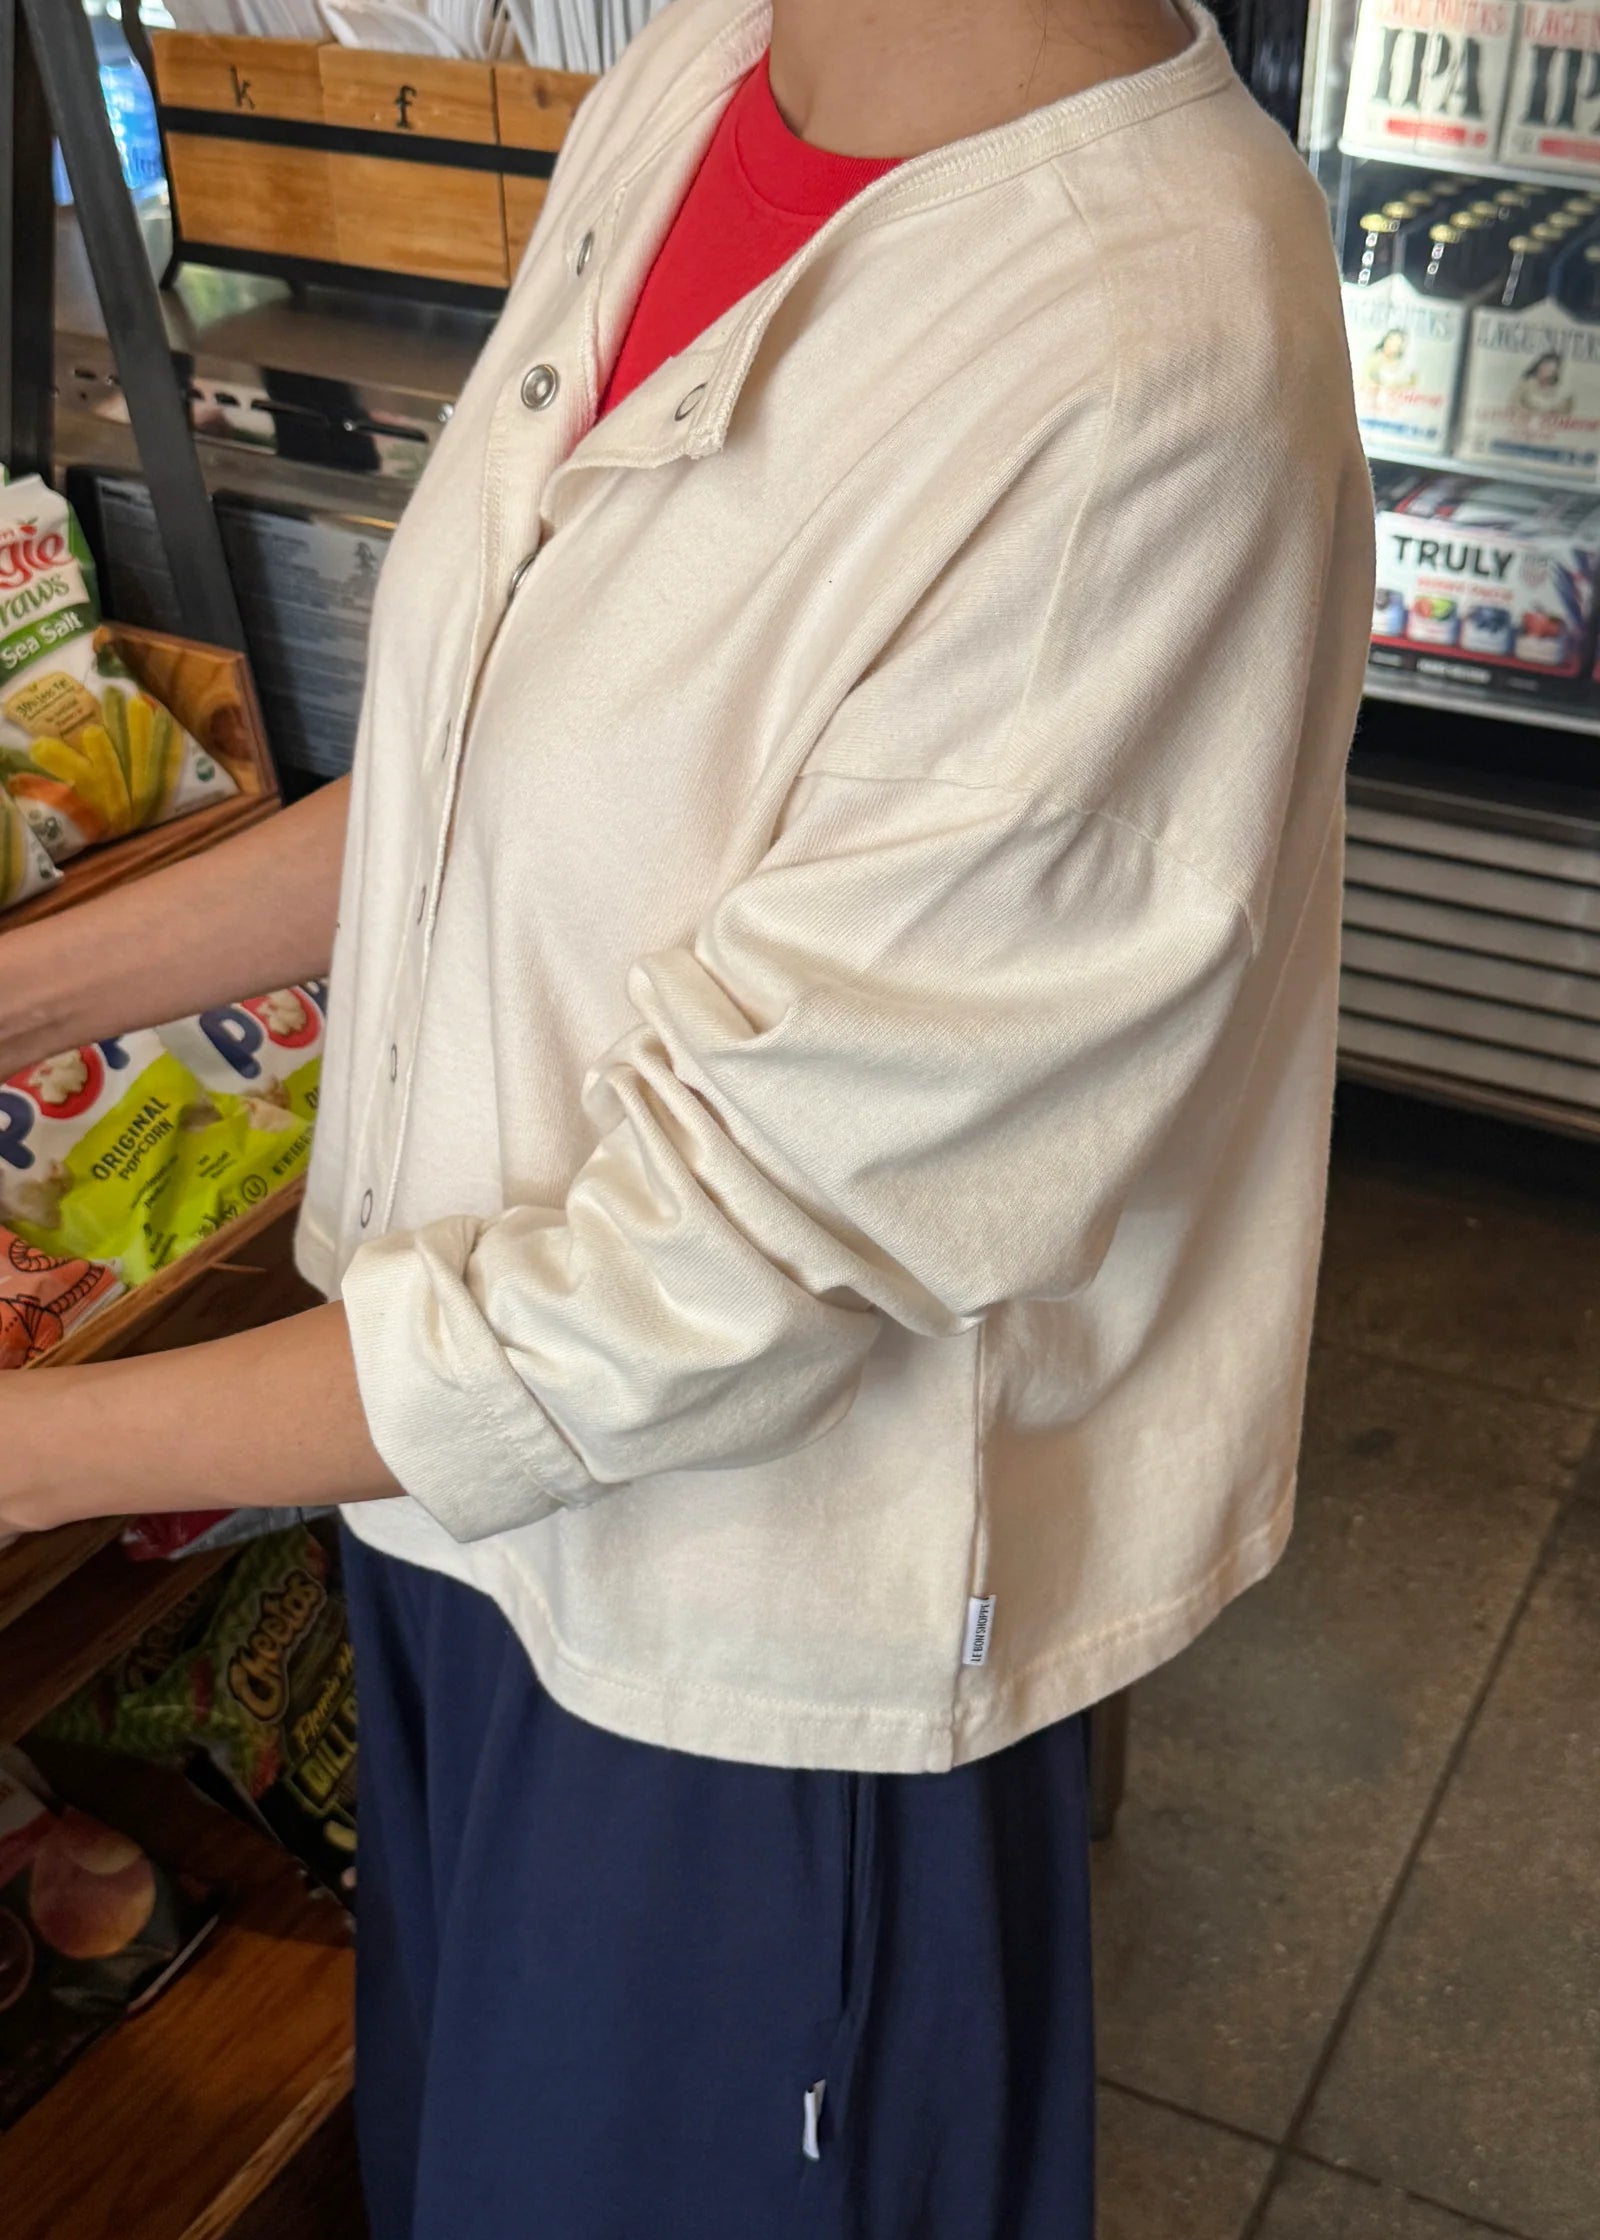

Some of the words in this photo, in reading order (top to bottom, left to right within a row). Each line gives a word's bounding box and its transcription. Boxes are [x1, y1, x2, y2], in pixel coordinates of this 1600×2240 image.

[230, 66, 255, 109] k
[1371, 26, 1484, 119] IPA
[1521, 45, 1600, 135] IP
[394, 85, 416, 128] f
[1392, 535, 1513, 580] TRULY
[2, 636, 40, 670] Sea
[40, 610, 84, 644] Salt
[91, 1096, 170, 1180] ORIGINAL
[119, 1117, 174, 1181] POPCORN
[229, 1571, 324, 1720] Cheetos
[973, 1634, 985, 1652] BON
